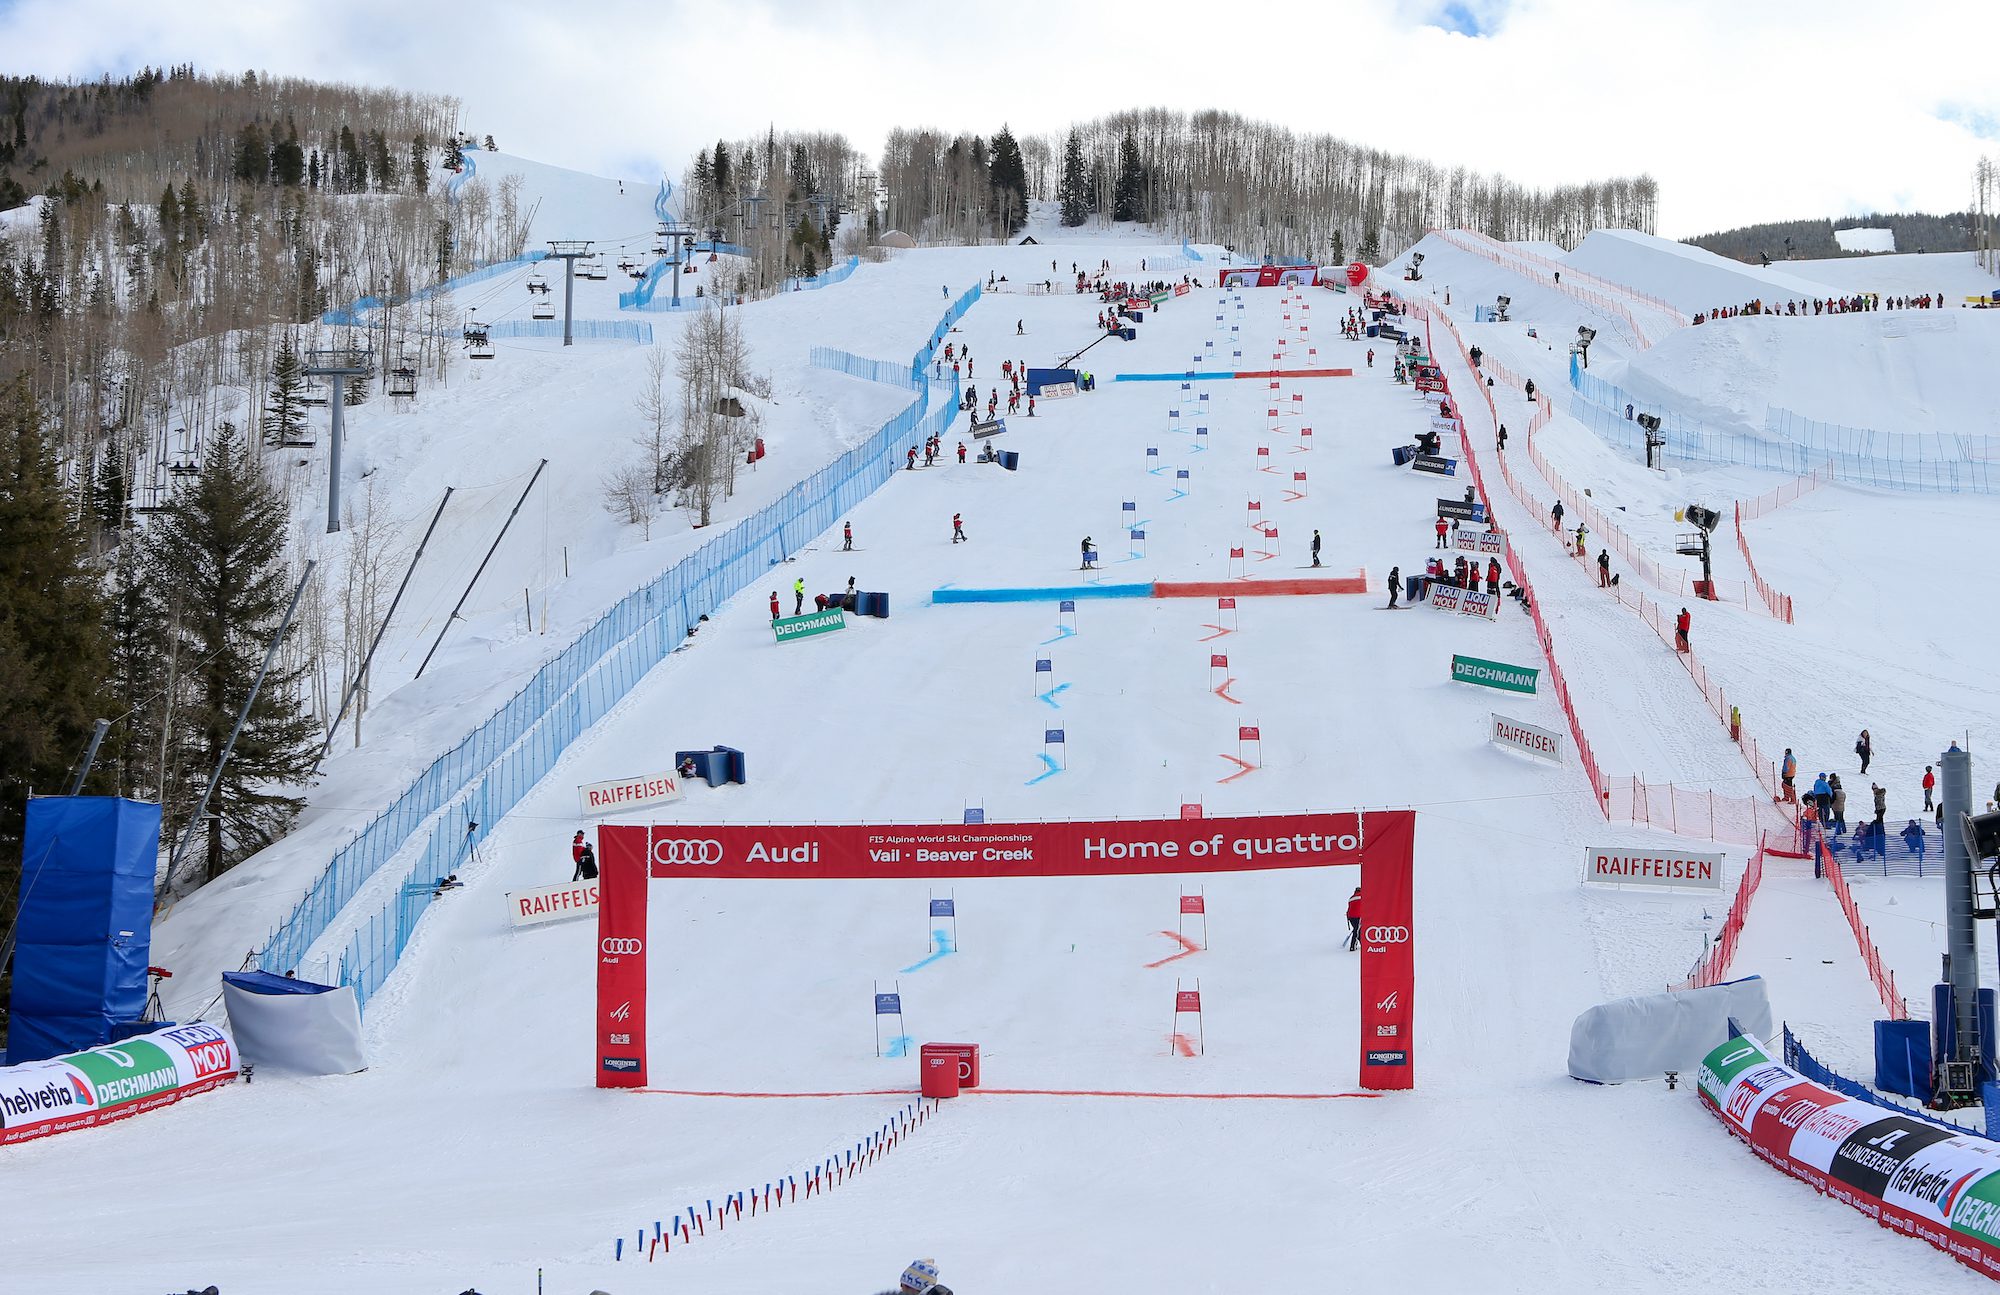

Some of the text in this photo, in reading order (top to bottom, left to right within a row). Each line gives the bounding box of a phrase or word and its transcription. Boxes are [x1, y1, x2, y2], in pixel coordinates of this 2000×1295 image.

[1458, 540, 1475, 550] MOLY
[1459, 532, 1476, 541] LIQUI
[1481, 534, 1501, 544] LIQUI
[1480, 543, 1500, 553] MOLY
[1433, 596, 1457, 608] MOLY
[1437, 585, 1461, 598] LIQUI
[1466, 591, 1490, 604] LIQUI
[1463, 601, 1487, 615] MOLY
[775, 613, 842, 635] DEICHMANN
[1456, 663, 1534, 687] DEICHMANN
[1497, 722, 1556, 754] RAIFFEISEN
[589, 778, 676, 807] RAIFFEISEN
[886, 835, 915, 844] Alpine
[917, 835, 945, 843] World
[947, 835, 961, 843] Ski
[962, 834, 1033, 843] Championships
[1084, 833, 1358, 860] Home of quattro
[746, 842, 819, 863] Audi
[869, 847, 1034, 862] Vail Beaver Creek
[1596, 855, 1712, 880] RAIFFEISEN
[519, 887, 599, 917] RAIFFEIS
[602, 956, 619, 964] Audi
[166, 1026, 222, 1048] LIQUI
[188, 1042, 229, 1073] MOLY
[604, 1058, 637, 1067] LONGINES
[1369, 1052, 1404, 1060] LONGINES
[98, 1066, 178, 1105] DEICHMANN
[0, 1081, 73, 1117] helvetia
[1728, 1084, 1759, 1120] MOLY
[1839, 1142, 1900, 1175] J.LINDEBERG
[1891, 1158, 1952, 1203] helvetia
